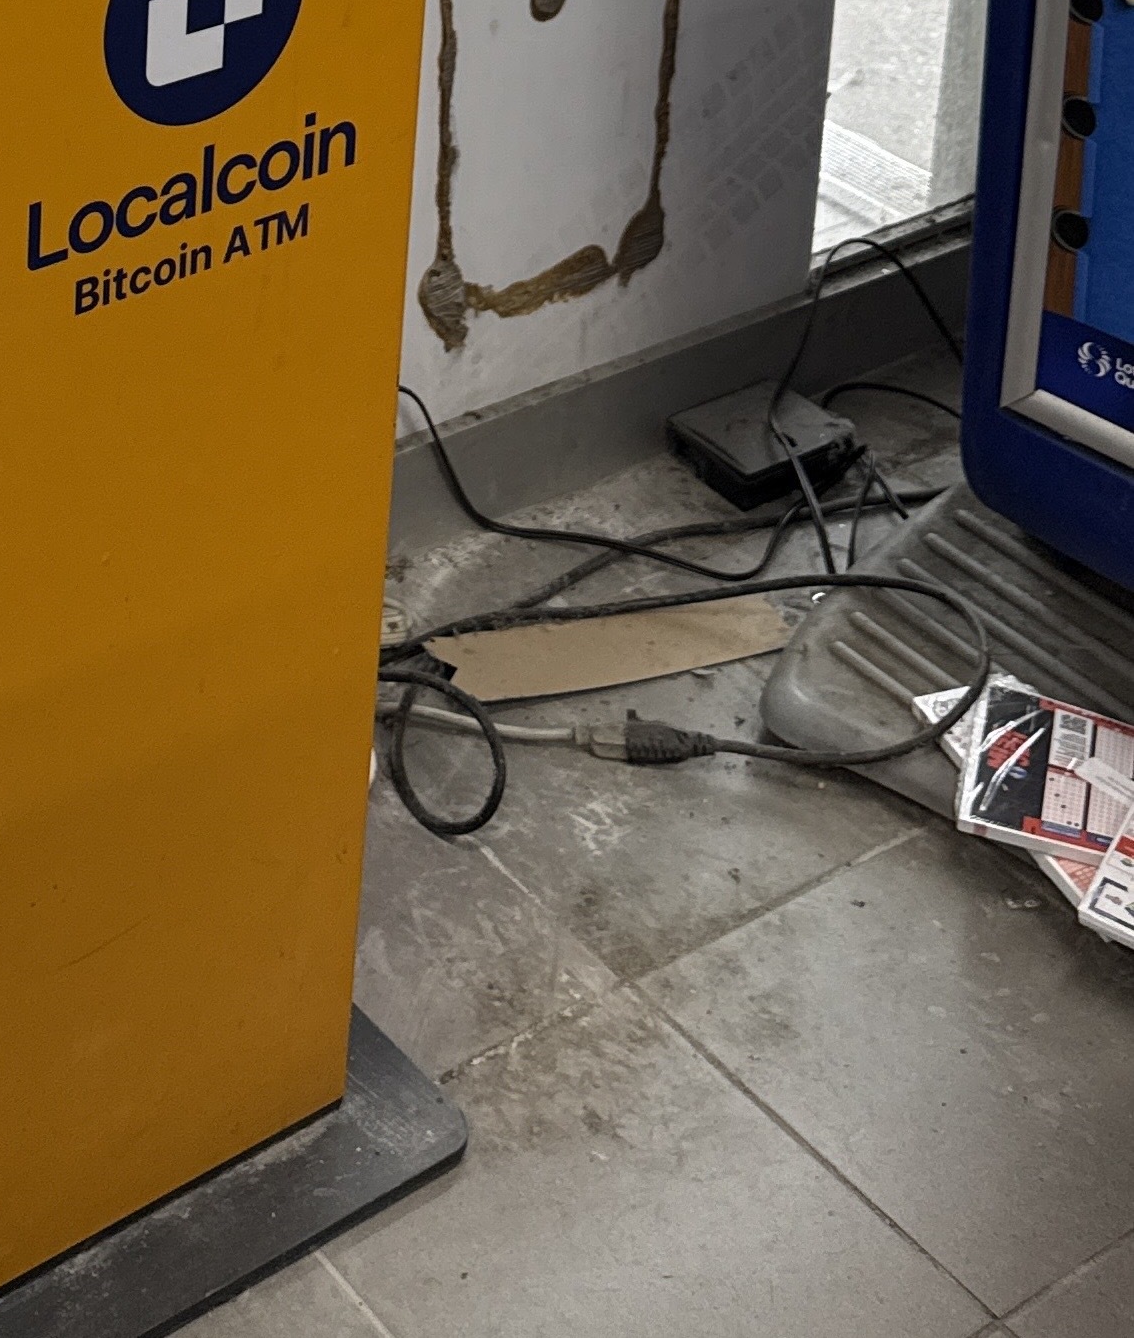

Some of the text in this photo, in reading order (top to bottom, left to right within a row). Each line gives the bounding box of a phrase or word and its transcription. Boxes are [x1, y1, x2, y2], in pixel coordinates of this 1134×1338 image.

[26, 111, 357, 271] Localcoin
[74, 202, 309, 316] Bitcoin ATM
